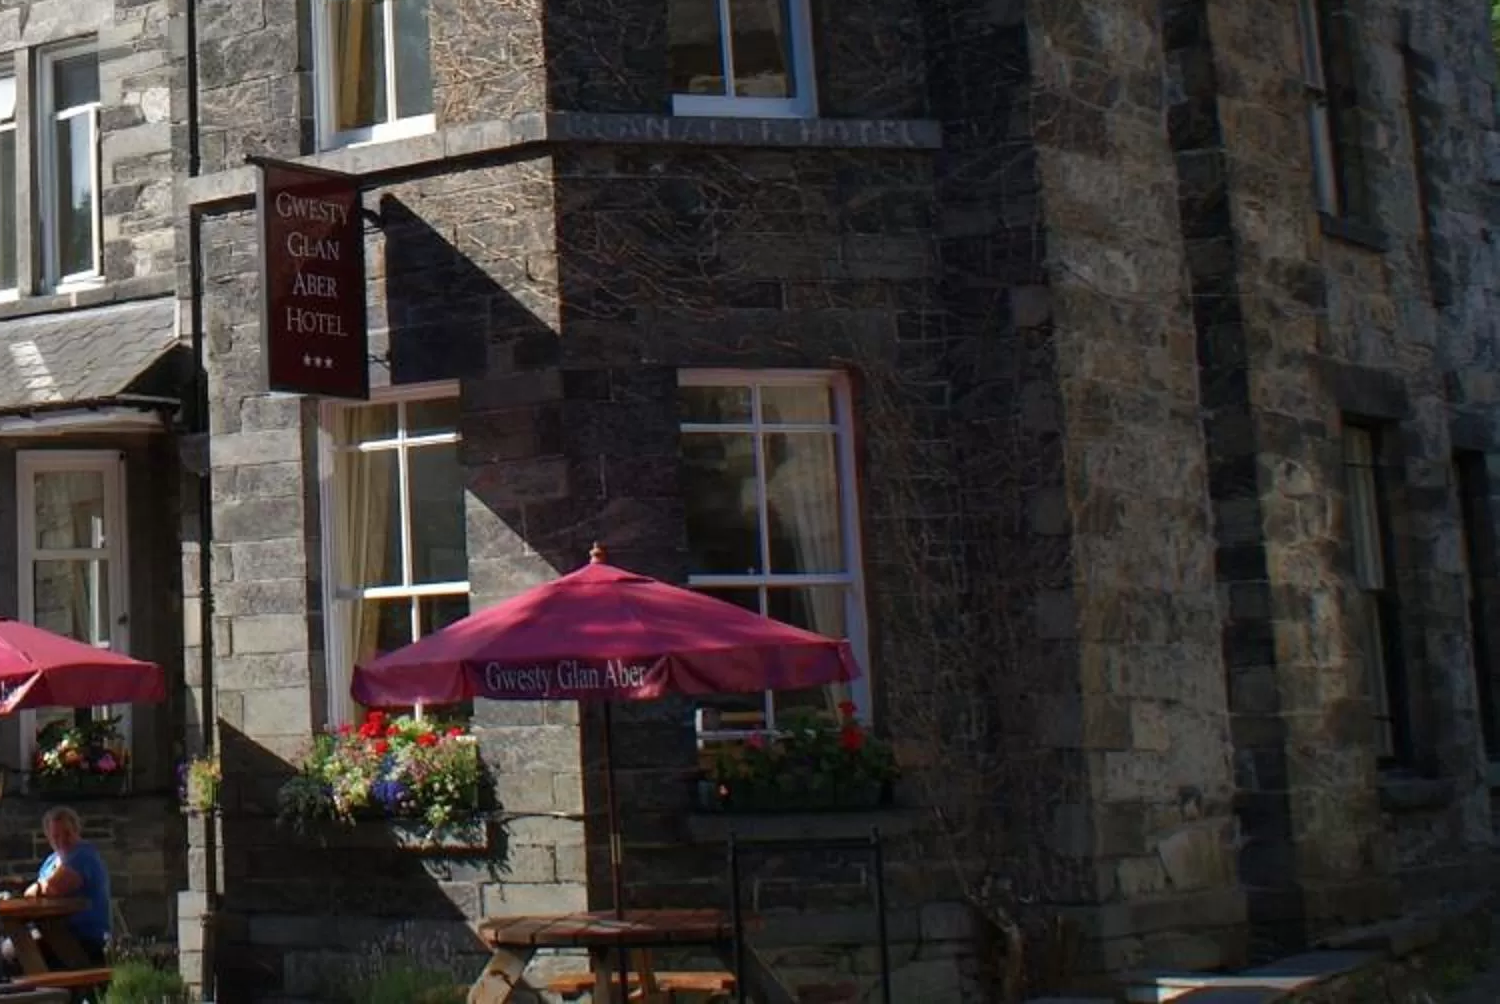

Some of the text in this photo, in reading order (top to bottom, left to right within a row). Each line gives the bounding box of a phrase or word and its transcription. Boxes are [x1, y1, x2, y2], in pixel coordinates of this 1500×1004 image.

[276, 192, 348, 226] GWESTY
[287, 232, 341, 261] GLAN
[293, 272, 338, 298] ABER
[286, 307, 348, 337] HOTEL
[486, 657, 646, 695] Gwesty Glan Aber
